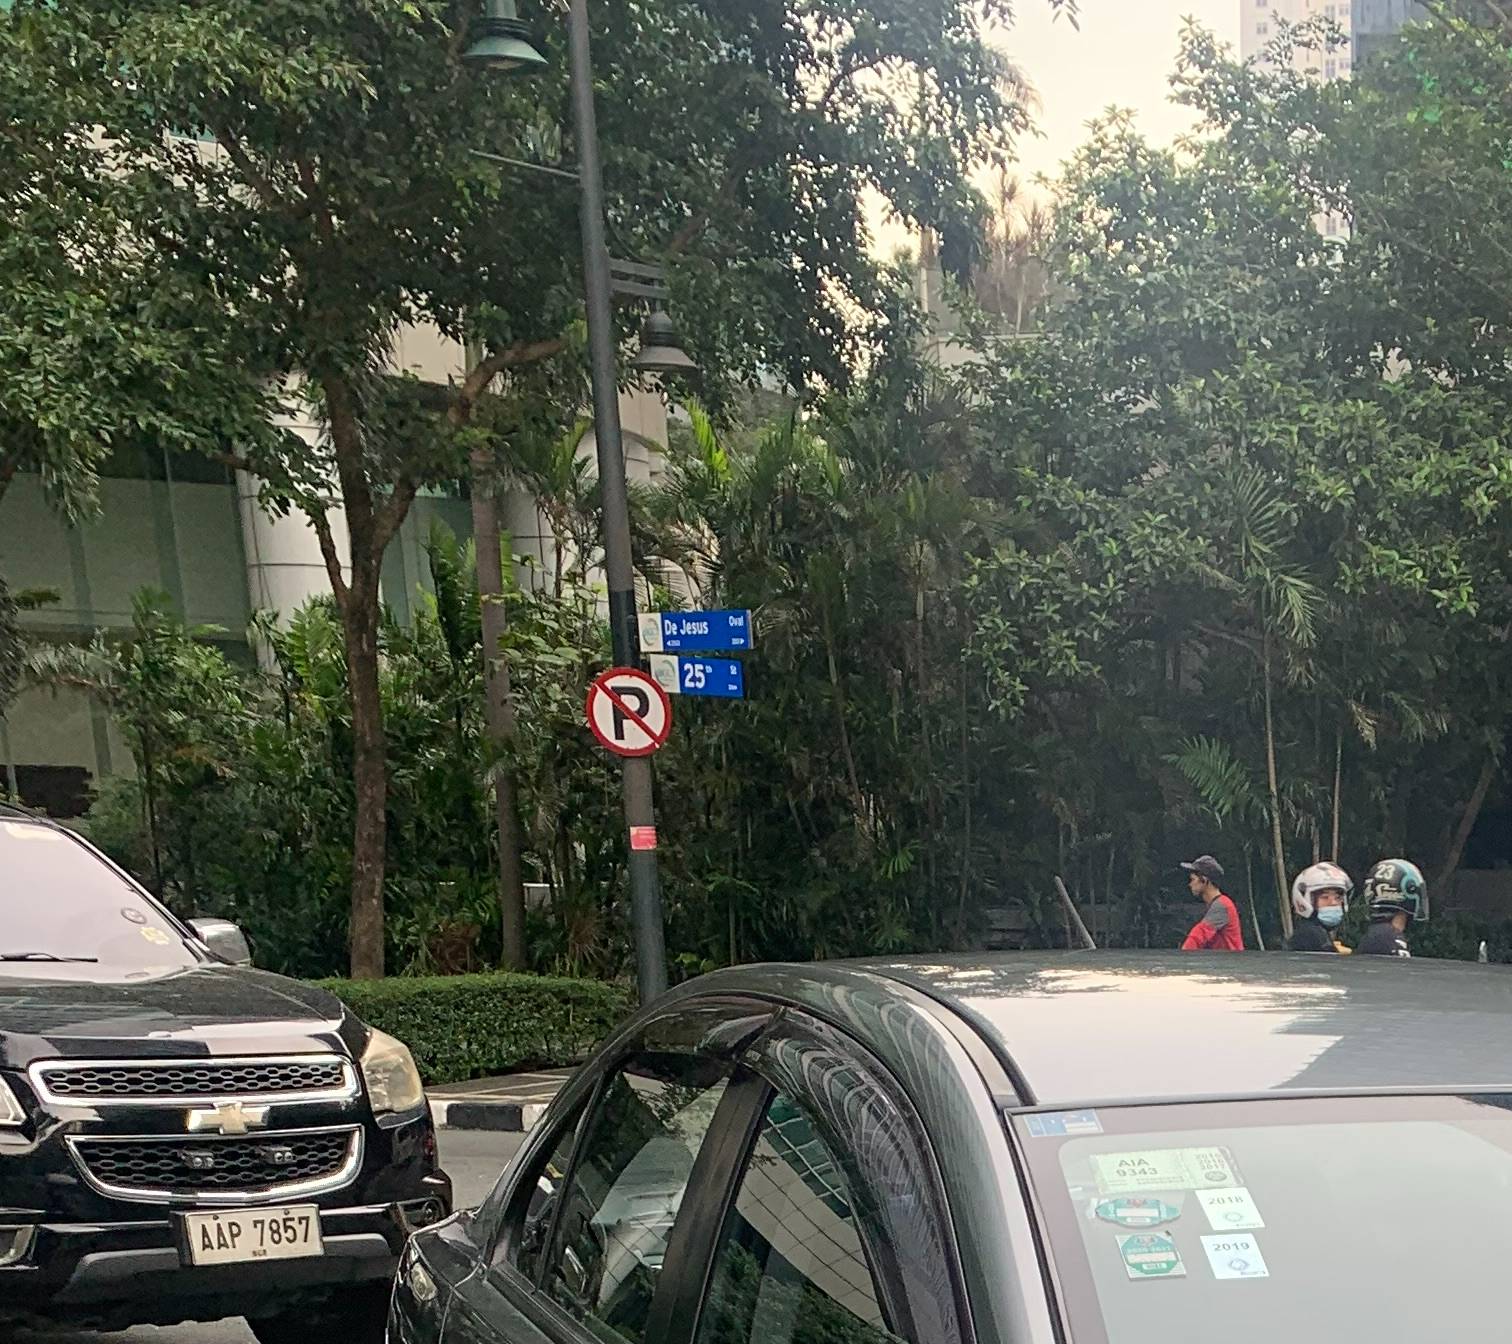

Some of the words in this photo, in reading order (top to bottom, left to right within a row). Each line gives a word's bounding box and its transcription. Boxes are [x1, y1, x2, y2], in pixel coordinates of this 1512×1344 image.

[664, 620, 677, 635] De
[680, 619, 708, 635] Jesus
[728, 615, 744, 627] Oval
[1374, 864, 1396, 880] 23
[201, 1221, 242, 1251] AAP
[252, 1215, 310, 1247] 7857
[1213, 1242, 1250, 1252] 2019
